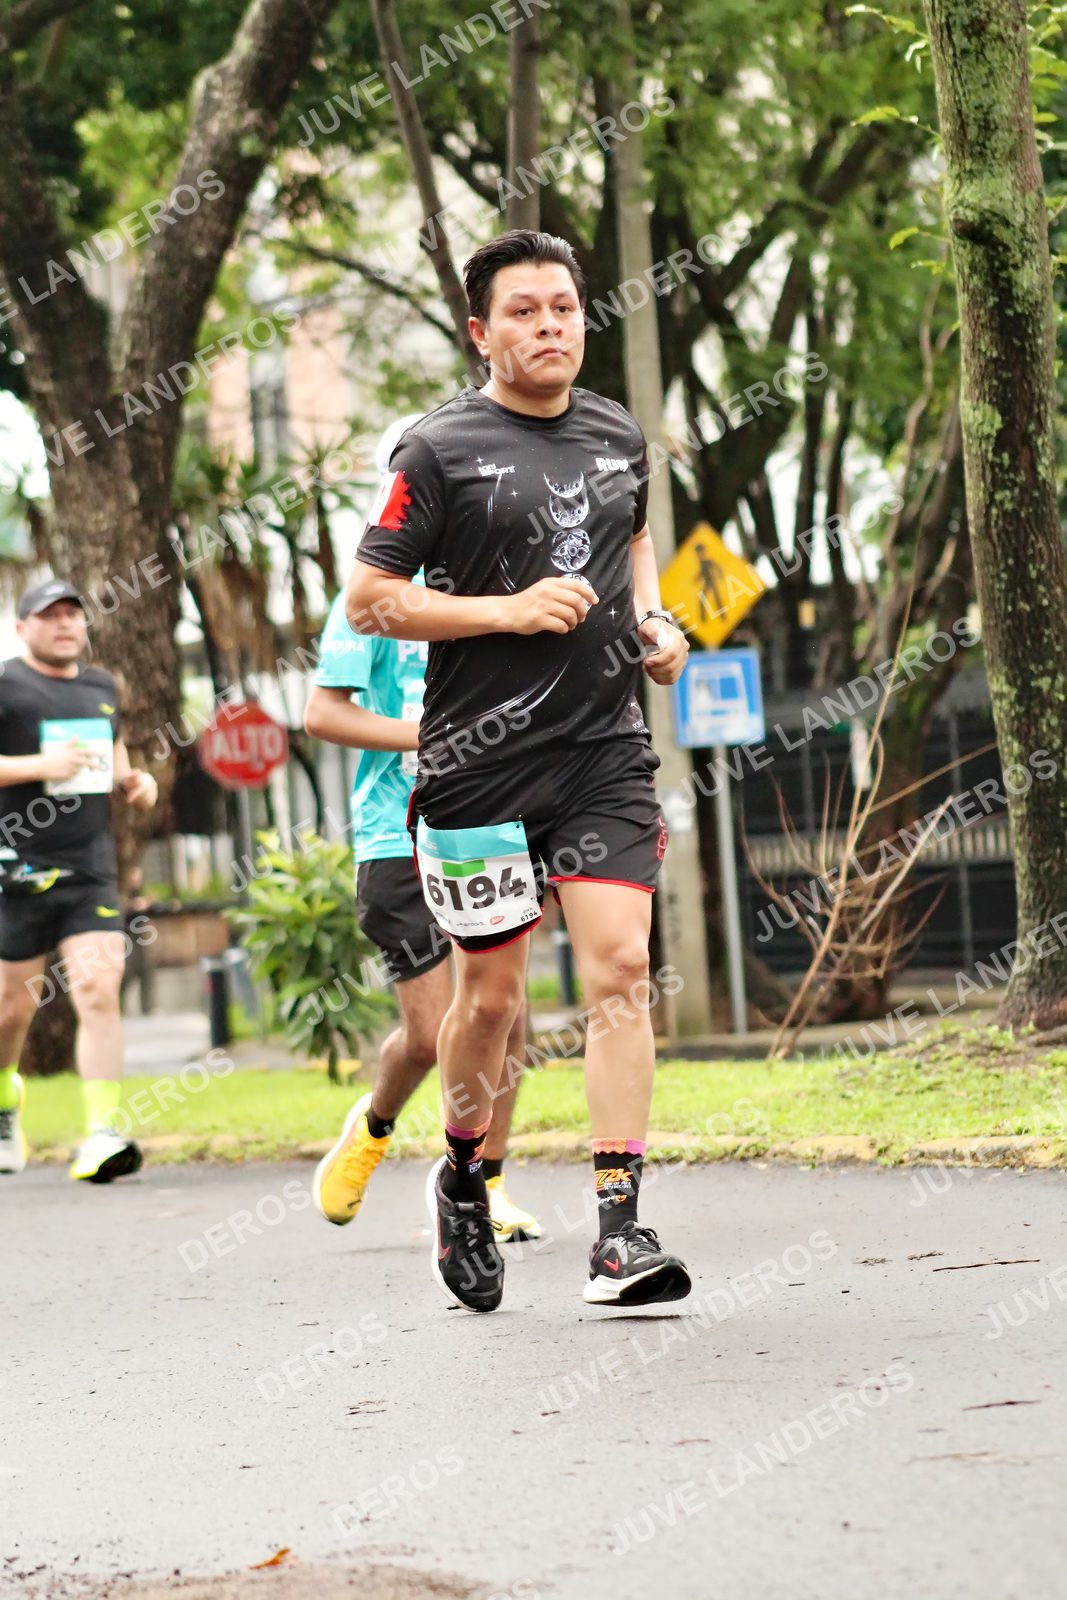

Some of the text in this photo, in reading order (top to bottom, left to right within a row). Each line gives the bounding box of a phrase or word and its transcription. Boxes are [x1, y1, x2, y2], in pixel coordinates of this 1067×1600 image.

[211, 724, 283, 764] ALTO
[426, 866, 528, 911] 6194
[520, 911, 539, 922] 6194
